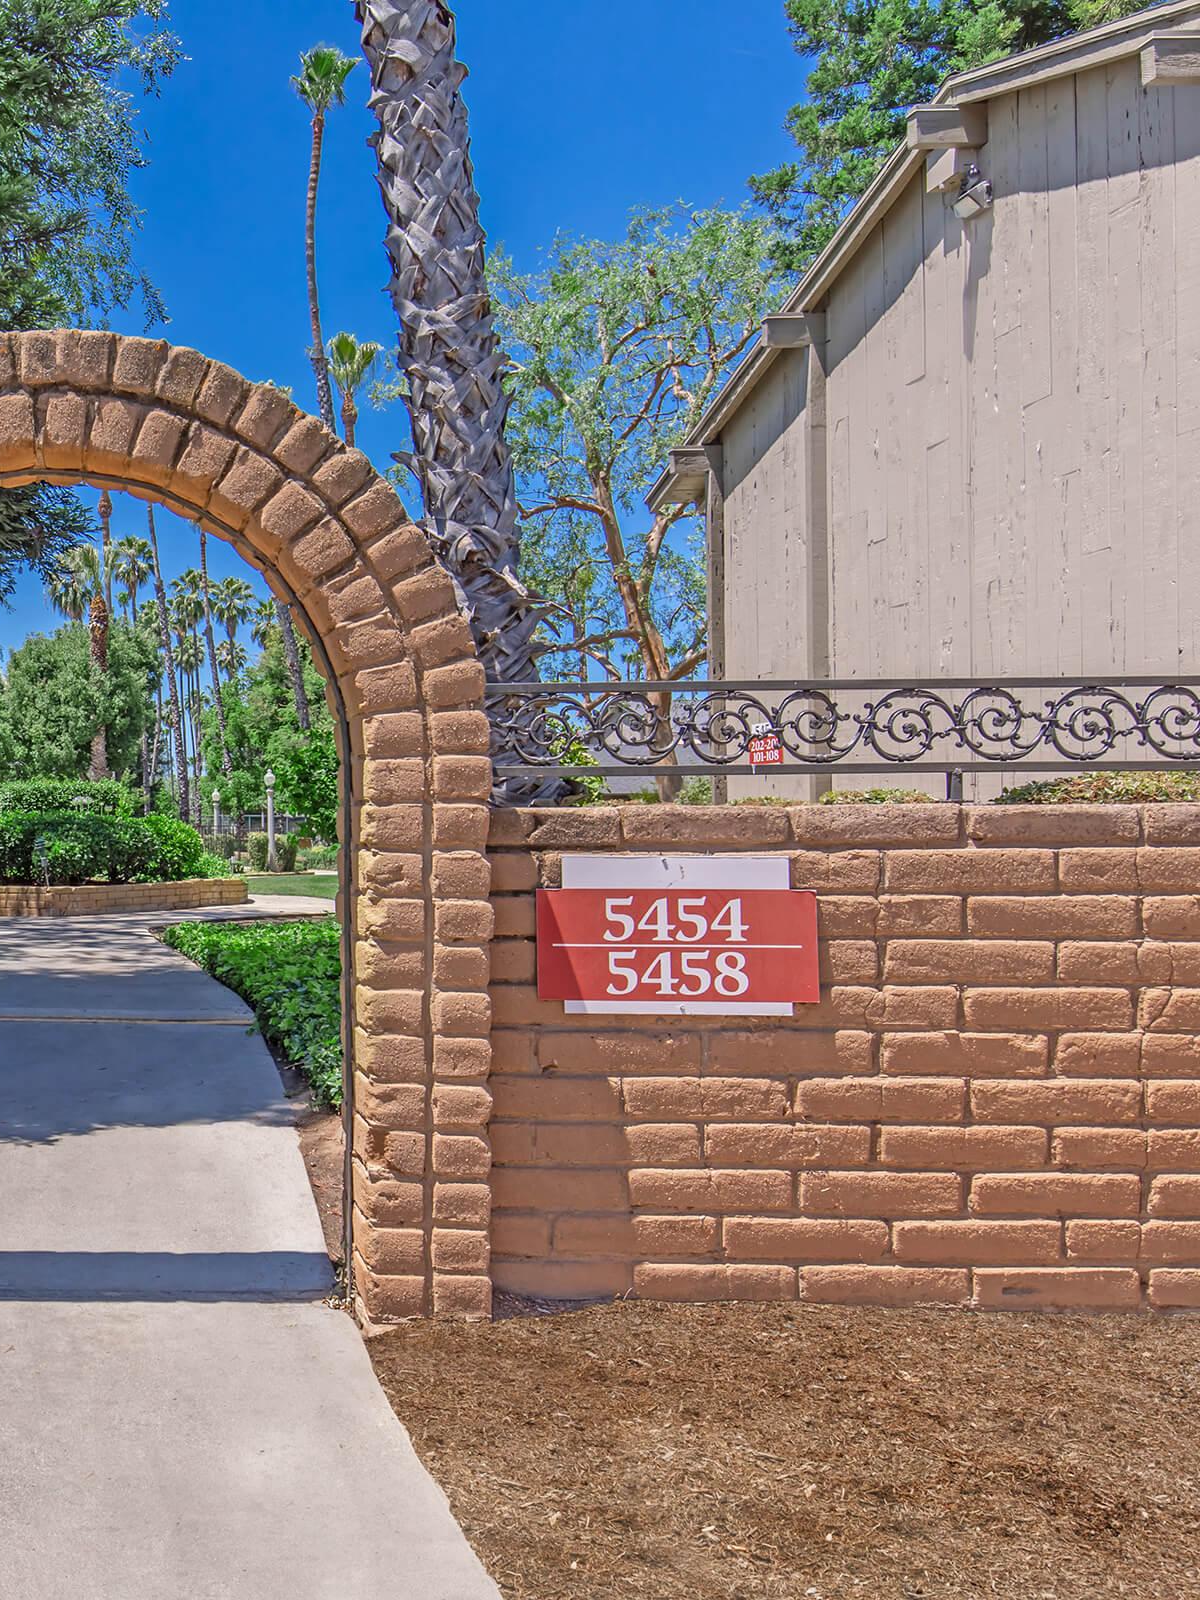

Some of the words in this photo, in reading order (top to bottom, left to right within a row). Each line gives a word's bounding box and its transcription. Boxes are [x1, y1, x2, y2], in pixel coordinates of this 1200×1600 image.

[753, 750, 779, 762] 101-108
[603, 896, 749, 942] 5454
[606, 949, 749, 996] 5458
